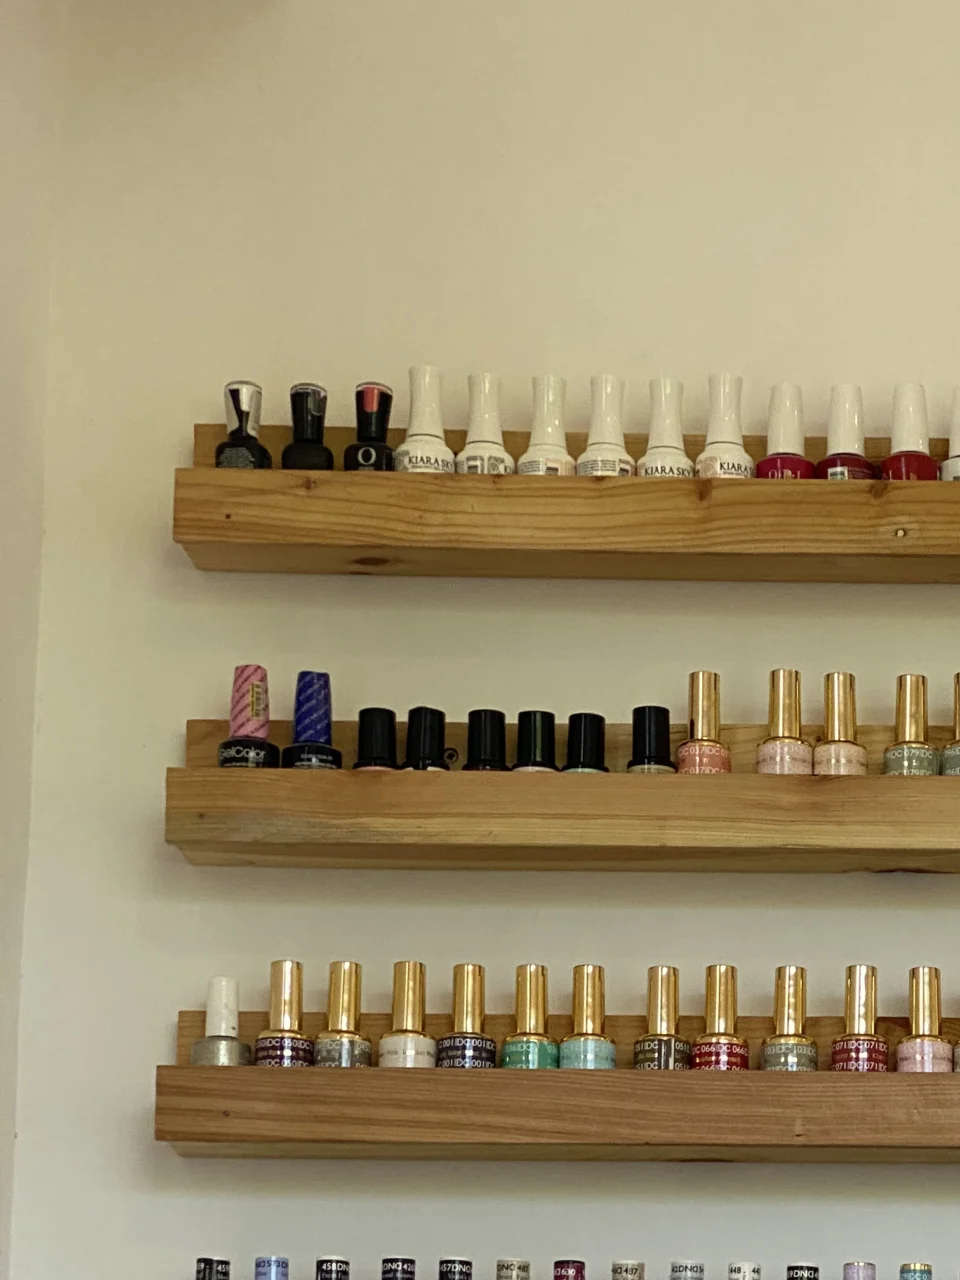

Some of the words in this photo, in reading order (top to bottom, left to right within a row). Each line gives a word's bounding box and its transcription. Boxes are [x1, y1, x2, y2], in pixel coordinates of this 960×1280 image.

[408, 455, 440, 466] KIARA
[644, 466, 674, 478] KIARA
[676, 467, 693, 478] SKY
[719, 461, 748, 474] KIARA
